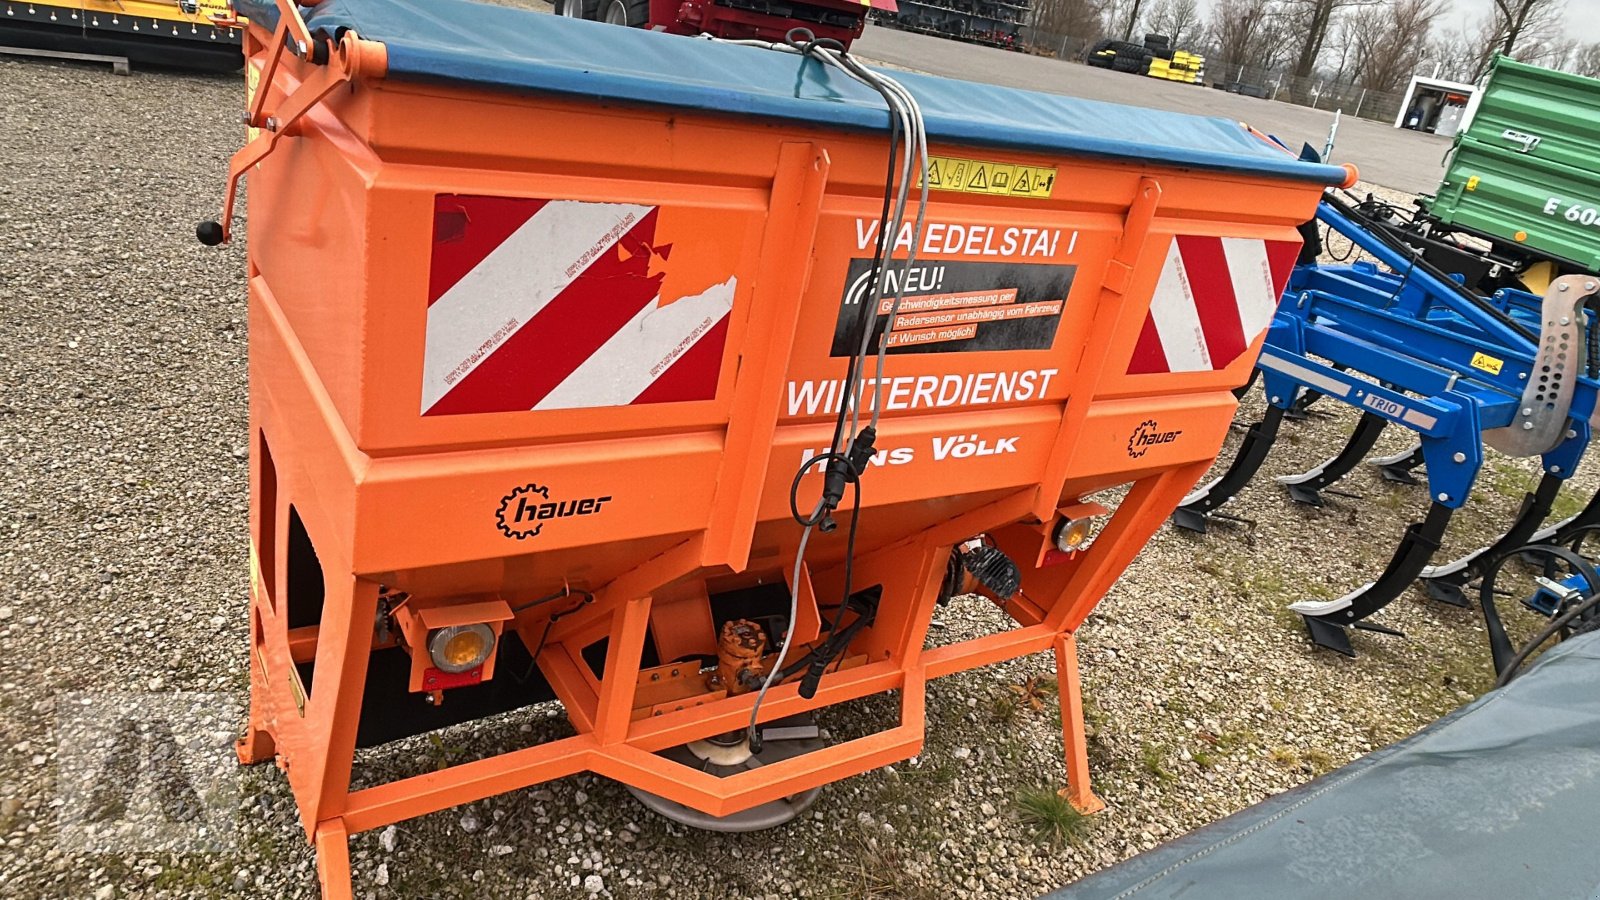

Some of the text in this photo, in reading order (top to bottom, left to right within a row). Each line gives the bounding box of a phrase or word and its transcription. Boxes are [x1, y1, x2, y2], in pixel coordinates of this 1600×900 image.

[1543, 197, 1561, 215] E
[883, 266, 945, 294] NEU!
[881, 293, 1014, 311] Gechwindigkeitsmessung per
[896, 314, 955, 327] Radarsensor
[1006, 307, 1023, 316] vom
[1024, 304, 1060, 314] Fahrzeug
[899, 332, 936, 343] Wunsch
[938, 326, 975, 339] möglich!
[1370, 397, 1398, 414] TRIO
[1136, 429, 1182, 447] hauer
[801, 434, 1020, 475] HNS VÖLK
[514, 497, 612, 523] hauer
